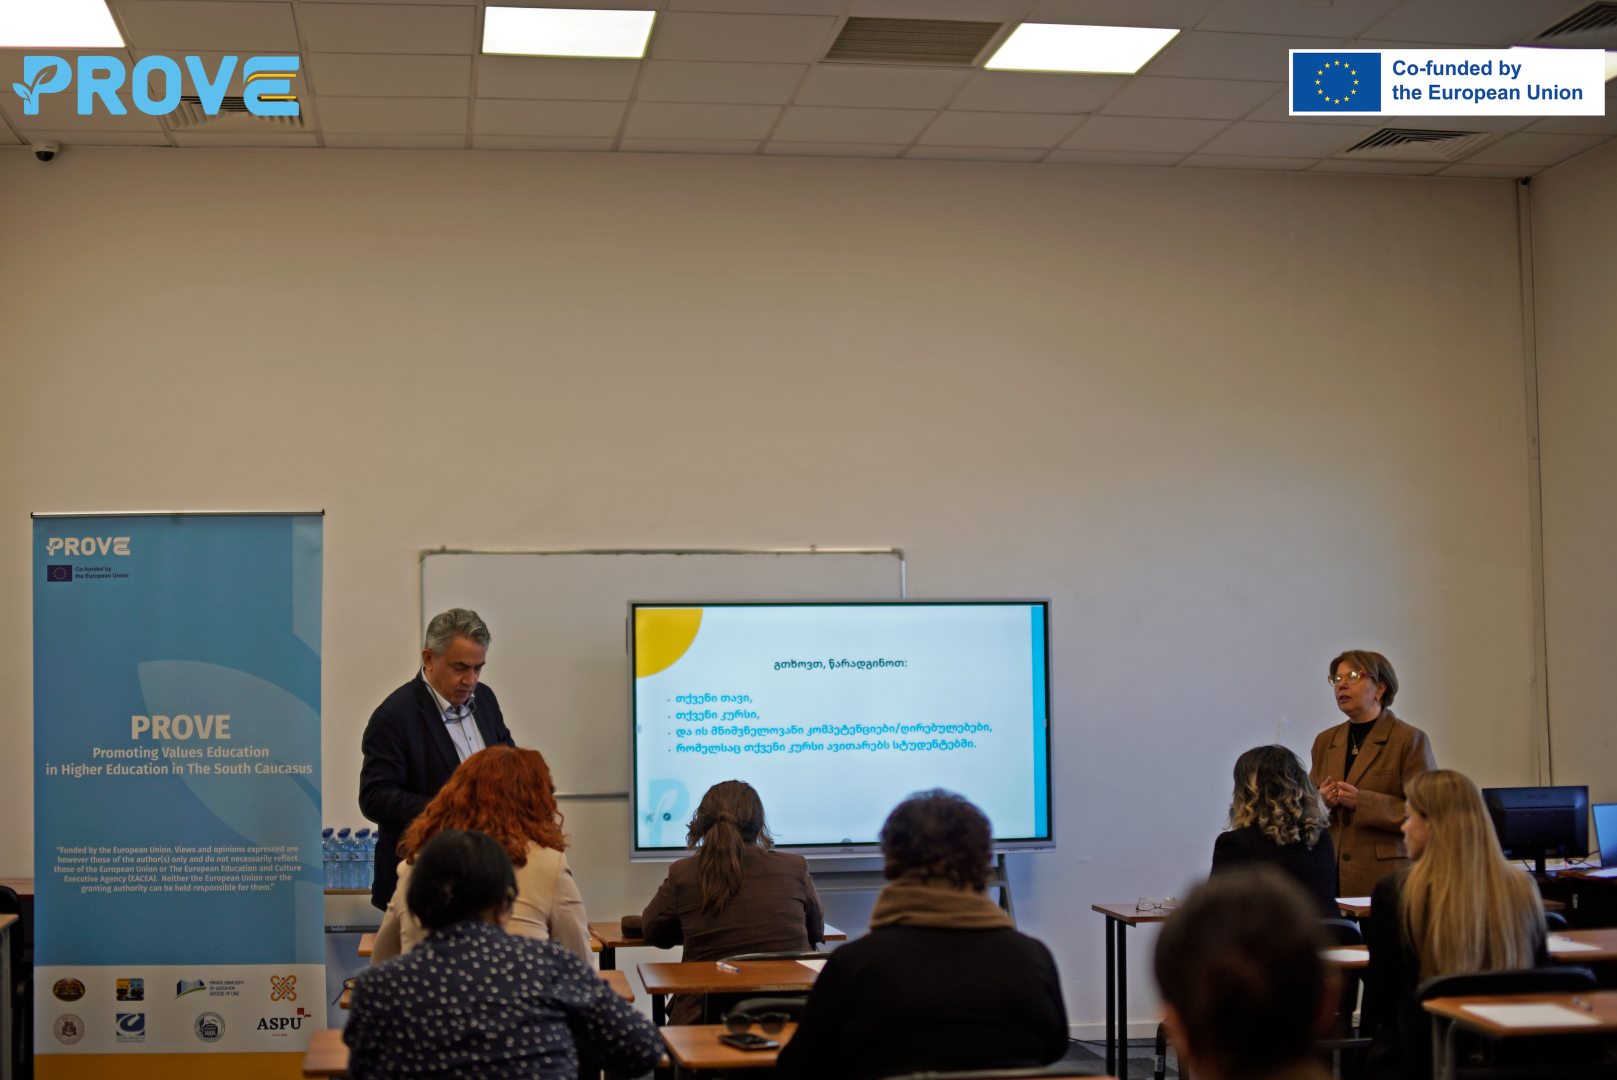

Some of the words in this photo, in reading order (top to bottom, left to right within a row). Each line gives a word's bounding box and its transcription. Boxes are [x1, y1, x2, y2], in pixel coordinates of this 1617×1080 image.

[46, 536, 130, 556] PROVE
[774, 657, 826, 671] გთხოვთ,
[829, 657, 908, 671] წარადგინოთ:
[676, 693, 717, 704] თქვენი
[721, 693, 752, 704] თავი,
[676, 710, 717, 721] თქვენი
[721, 710, 760, 721] კურსი,
[131, 714, 231, 740] PROVE
[676, 726, 692, 737] და
[695, 725, 708, 736] ის
[711, 724, 804, 737] მნიშვნელოვანი
[676, 742, 740, 754] რომელსაც
[744, 742, 785, 753] თქვენი
[788, 741, 824, 753] კურსი
[827, 739, 889, 751] ავითარებს
[93, 746, 158, 760] Promoting
[162, 746, 203, 758] Values
[207, 746, 269, 758] Education
[46, 762, 57, 775] in
[61, 762, 102, 777] Higher
[106, 762, 168, 775] Education
[172, 762, 184, 775] in
[187, 762, 210, 775] The
[214, 762, 251, 775] South
[255, 762, 312, 775] Caucasus
[88, 845, 97, 855] by
[99, 845, 111, 853] the
[113, 845, 148, 855] European
[150, 845, 173, 853] Union.
[174, 845, 196, 853] Views
[198, 845, 212, 853] and
[214, 845, 245, 855] opinions
[247, 845, 284, 855] expressed
[58, 855, 88, 863] however
[90, 855, 110, 863] those
[112, 855, 120, 863] of
[122, 855, 135, 863] the
[136, 855, 170, 864] author(s)
[172, 855, 187, 864] only
[189, 855, 203, 863] and
[205, 855, 214, 863] do
[216, 855, 229, 863] not
[231, 855, 272, 864] necessarily
[274, 855, 298, 863] reflect
[54, 864, 75, 872] those
[76, 864, 84, 872] of
[86, 864, 98, 872] the
[100, 864, 134, 874] European
[136, 864, 158, 872] Union
[169, 864, 183, 872] The
[185, 864, 219, 874] European
[221, 864, 258, 872] Education
[259, 864, 273, 872] and
[275, 864, 302, 872] Culture
[64, 874, 98, 882] Executive
[100, 874, 126, 884] Agency
[128, 874, 158, 884] (EACEA).
[161, 874, 189, 882] Neither
[190, 874, 203, 882] the
[205, 874, 240, 884] European
[242, 874, 263, 882] Union
[279, 874, 292, 882] the
[81, 883, 112, 893] granting
[113, 883, 147, 893] authority
[164, 883, 173, 891] be
[175, 883, 191, 891] held
[193, 883, 236, 893] responsible
[238, 883, 249, 891] for
[257, 1018, 302, 1030] ASPU
